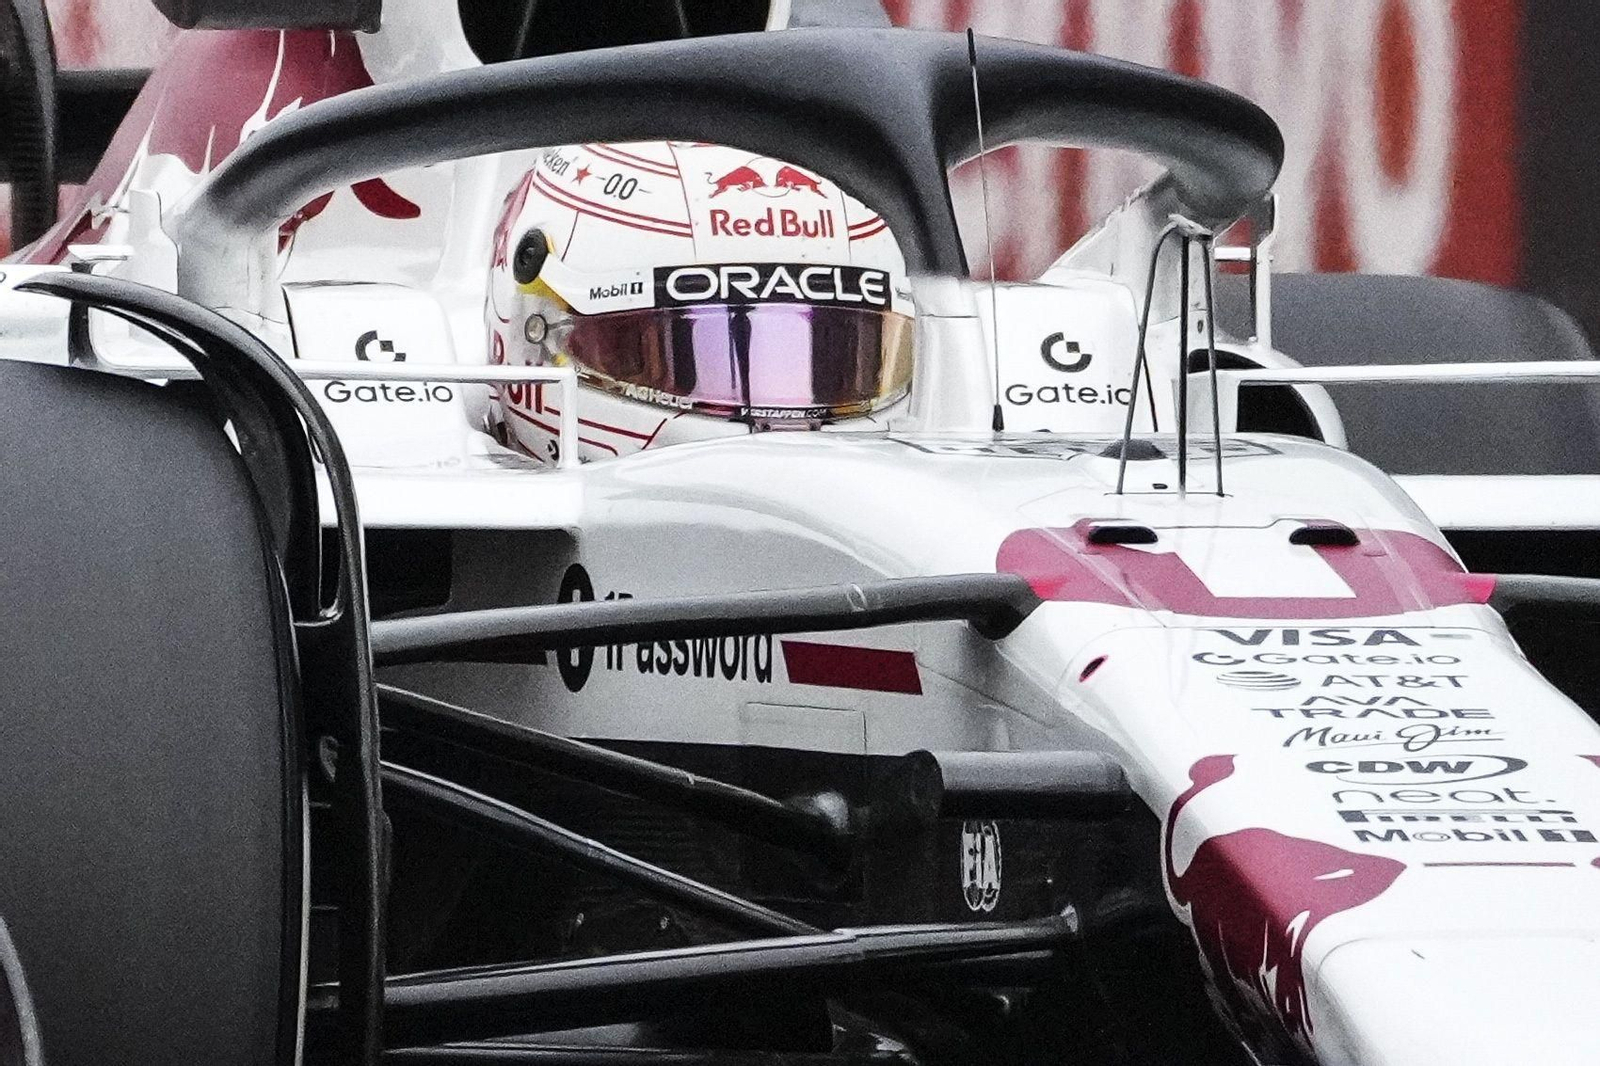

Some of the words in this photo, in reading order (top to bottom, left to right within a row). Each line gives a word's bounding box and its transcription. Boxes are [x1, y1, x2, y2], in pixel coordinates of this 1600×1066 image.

[710, 208, 775, 238] Red
[781, 208, 835, 239] Bull
[589, 283, 628, 301] Mobil
[666, 267, 887, 305] ORACLE
[323, 381, 454, 403] Gate.io
[1211, 629, 1422, 647] VISA
[1253, 653, 1462, 666] Gate.io
[1321, 674, 1470, 688] AT&T
[1300, 696, 1432, 706] AVA
[1251, 708, 1496, 719] TRADE
[1282, 726, 1383, 748] Maui
[1396, 723, 1496, 752] Jim
[1305, 760, 1476, 774] CDW
[1353, 829, 1529, 843] Mobil
